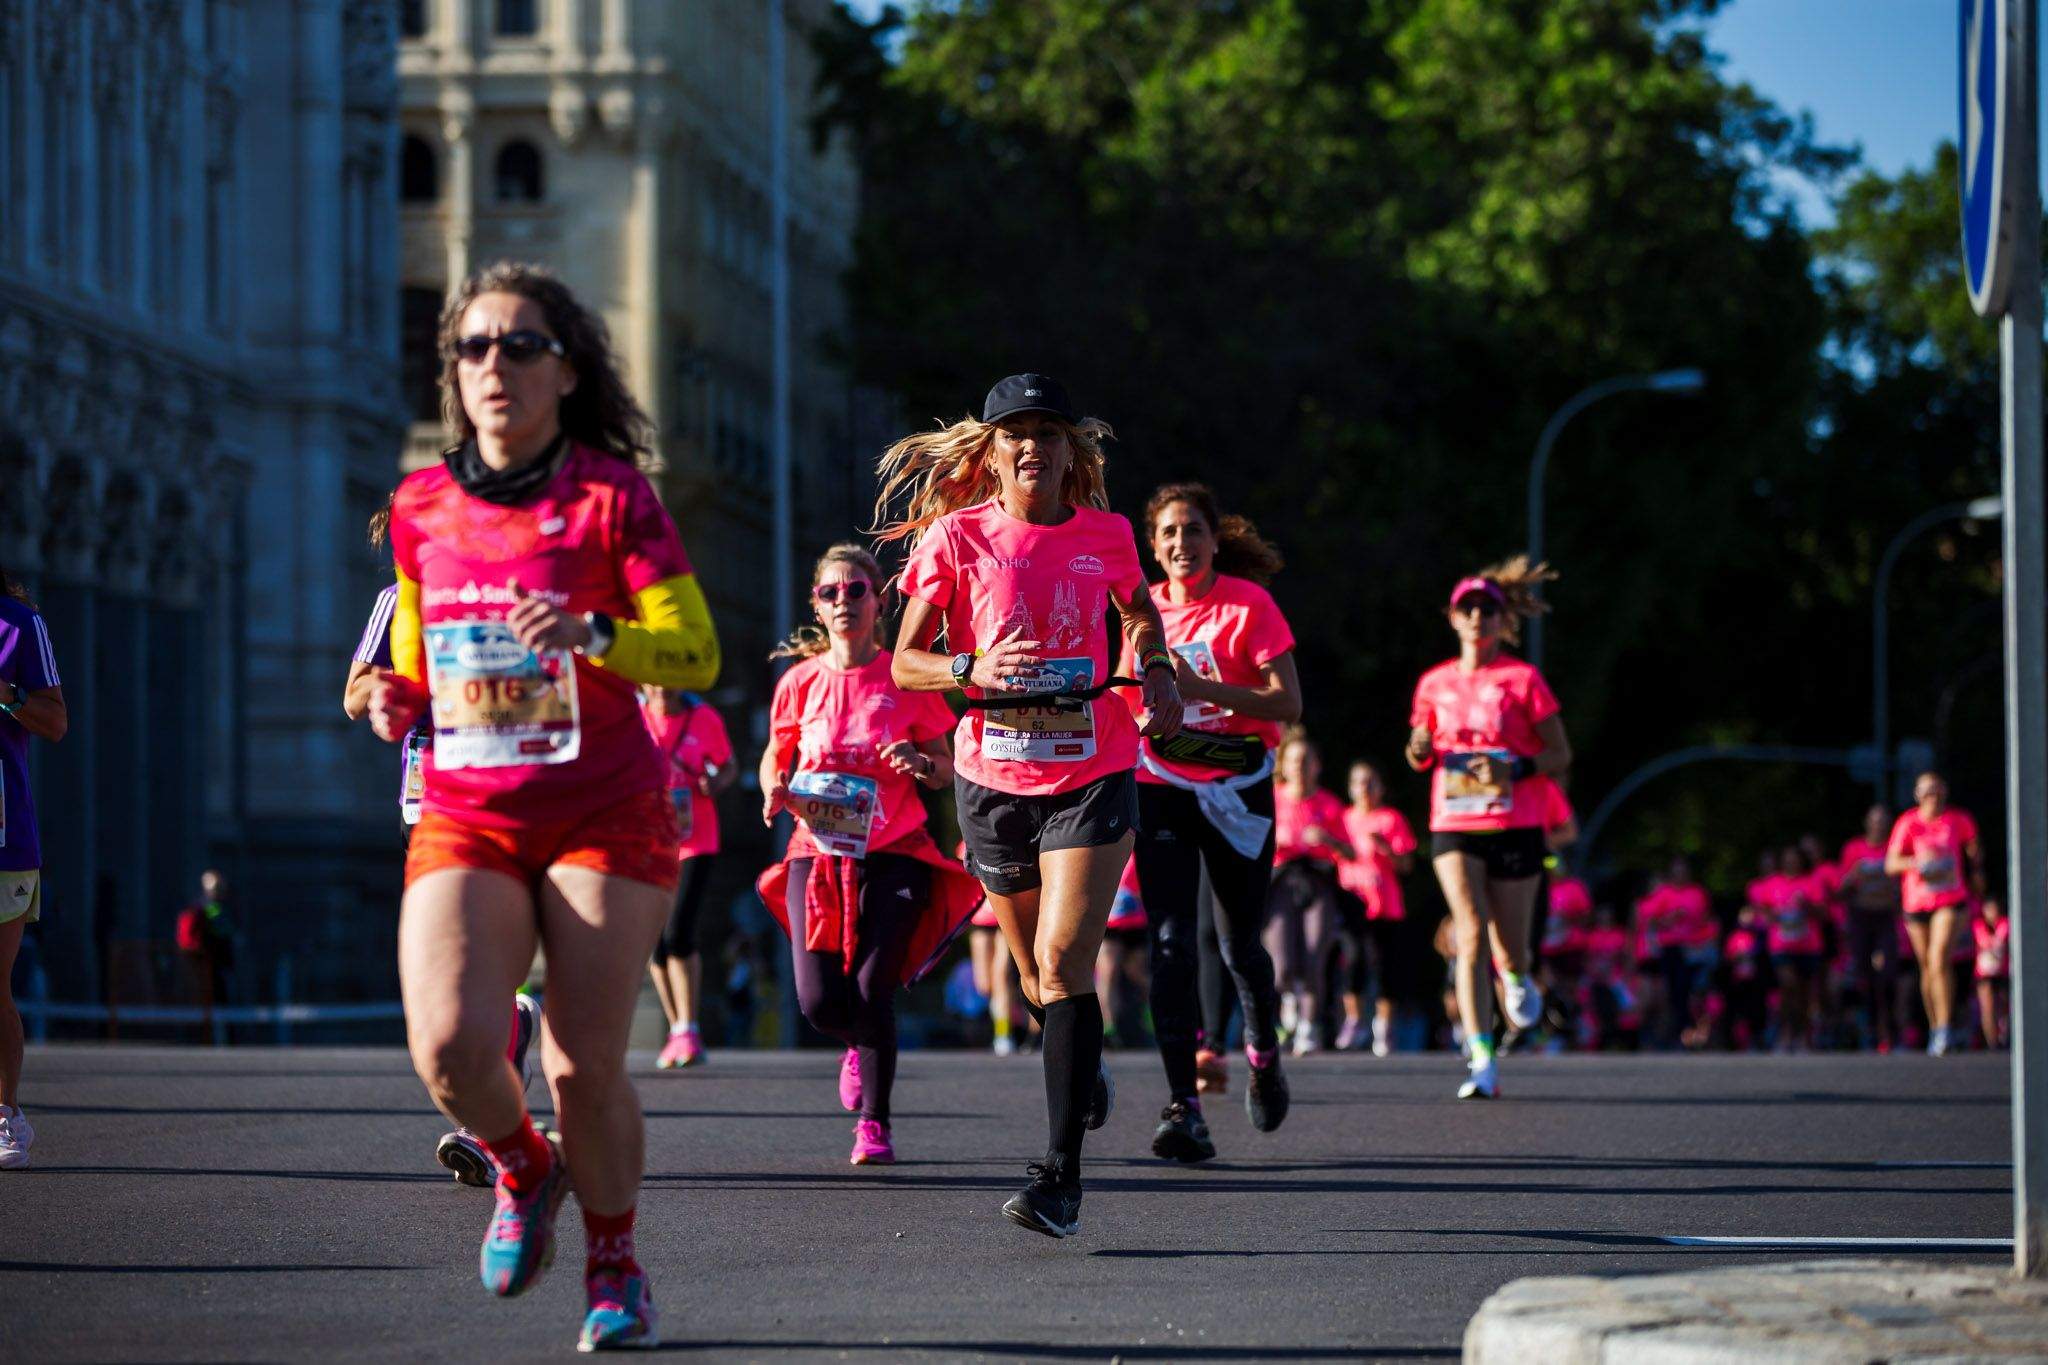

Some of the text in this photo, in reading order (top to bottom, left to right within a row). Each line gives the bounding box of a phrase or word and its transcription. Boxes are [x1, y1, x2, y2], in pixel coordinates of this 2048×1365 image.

[981, 558, 1030, 569] OYSHO
[465, 678, 525, 705] 016
[1032, 720, 1045, 730] 62
[991, 743, 1024, 754] OYSHO
[807, 801, 844, 819] 016
